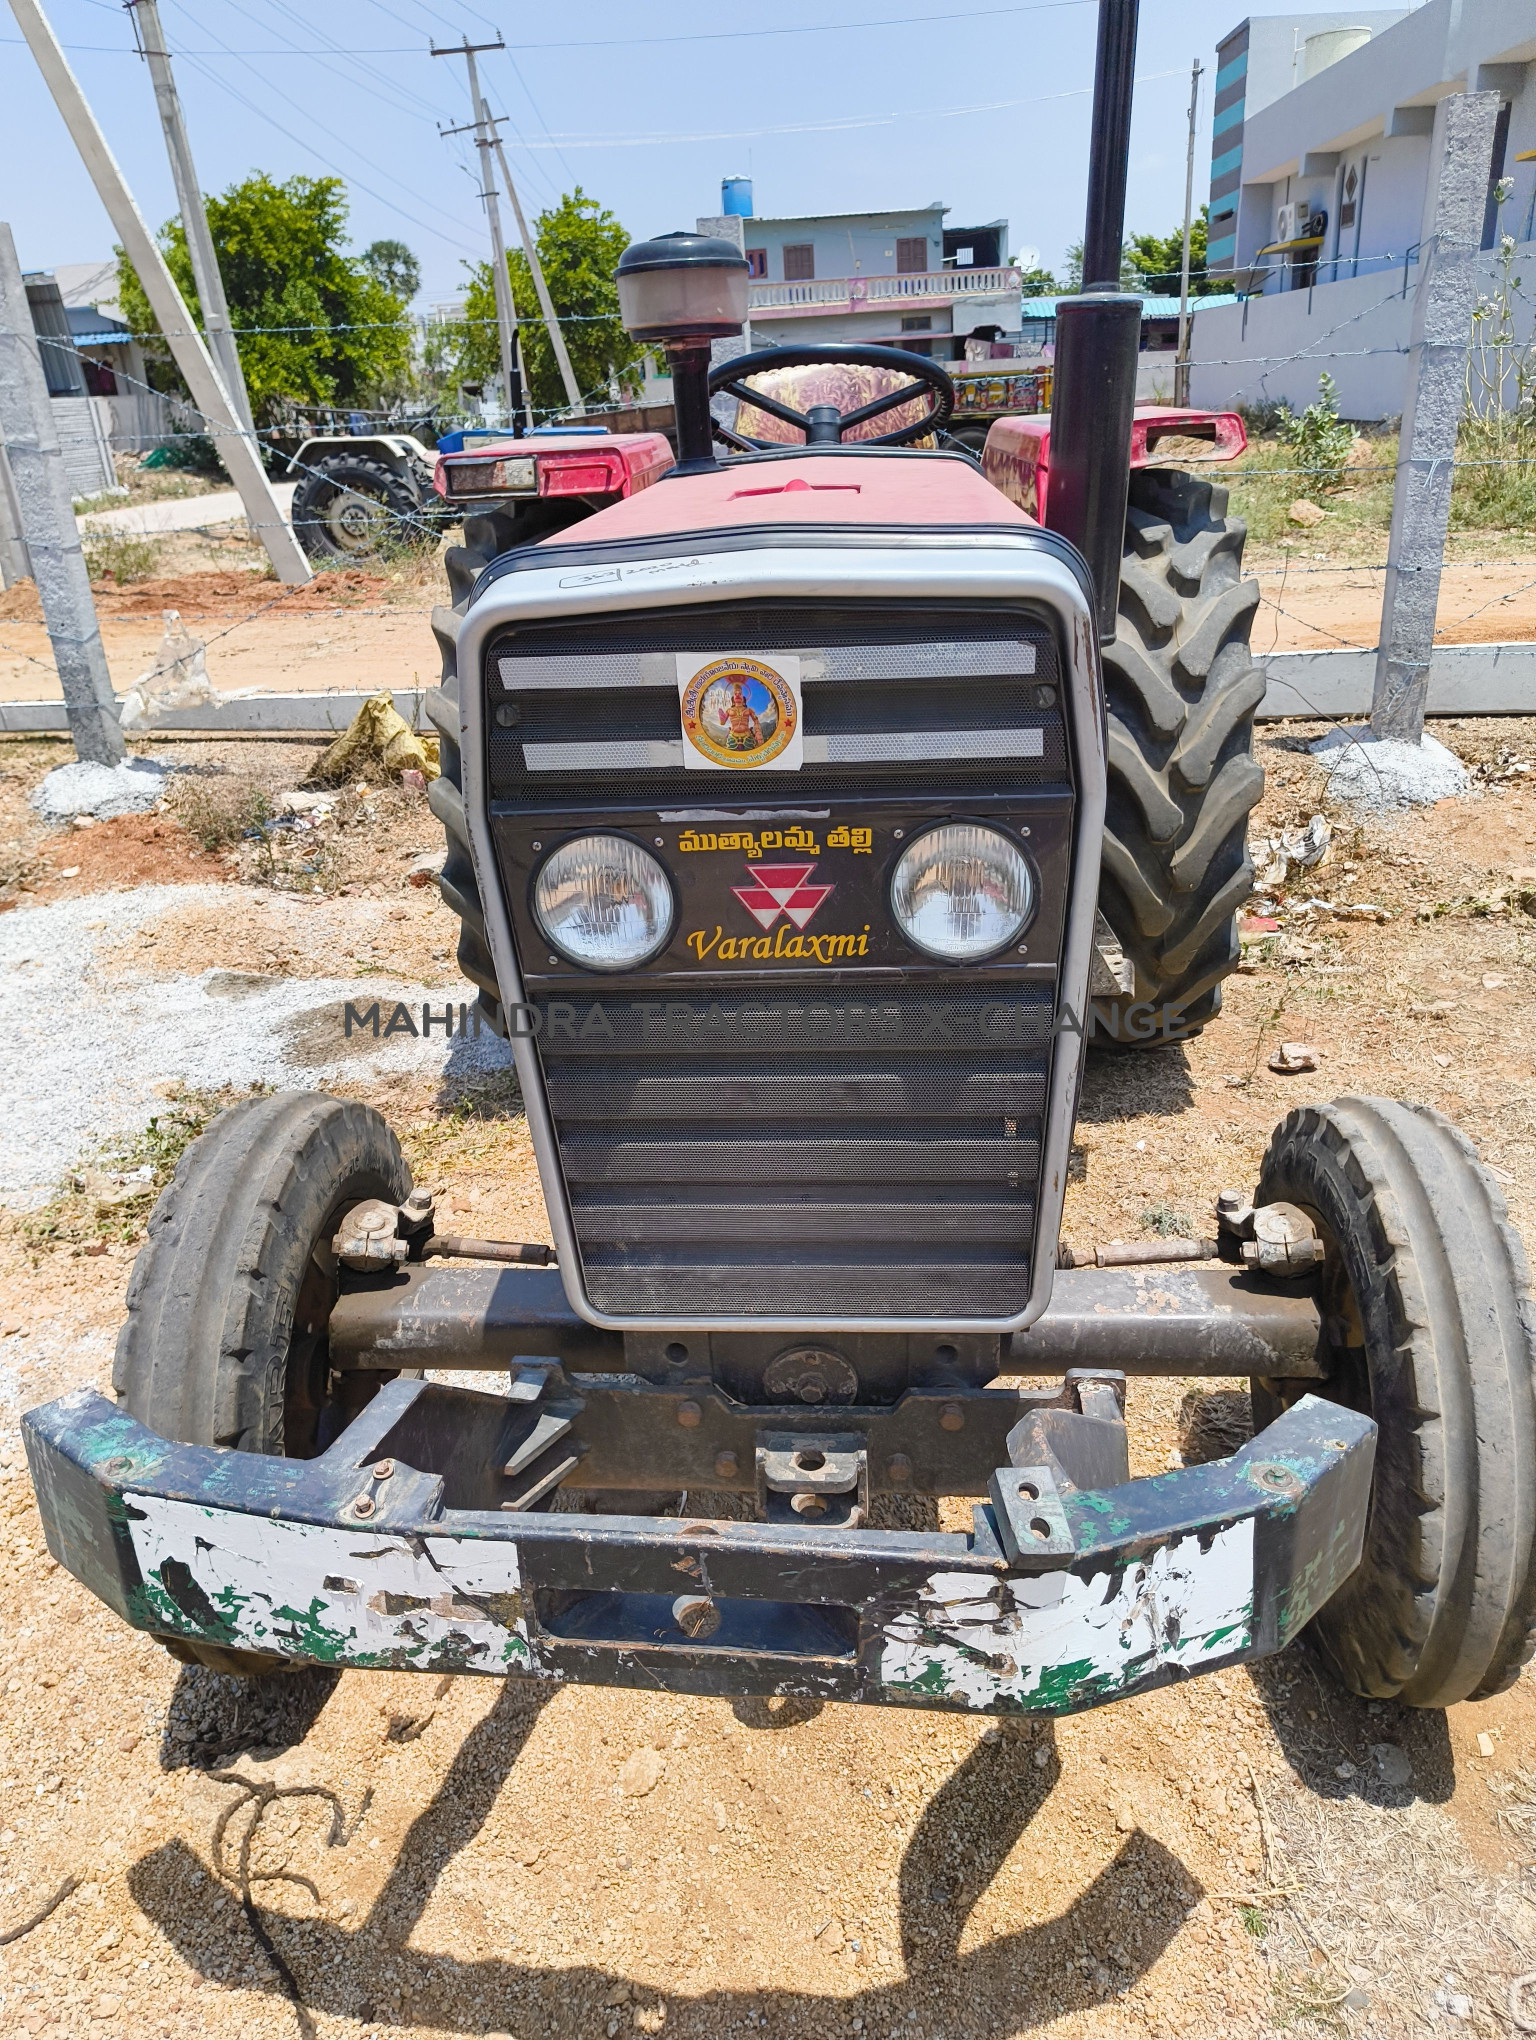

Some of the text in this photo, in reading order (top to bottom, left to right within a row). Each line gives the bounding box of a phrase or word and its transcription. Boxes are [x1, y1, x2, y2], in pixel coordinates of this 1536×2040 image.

[678, 826, 873, 858] ముత్యాలమ్మ తల్లి
[686, 924, 871, 964] Varalaxmi
